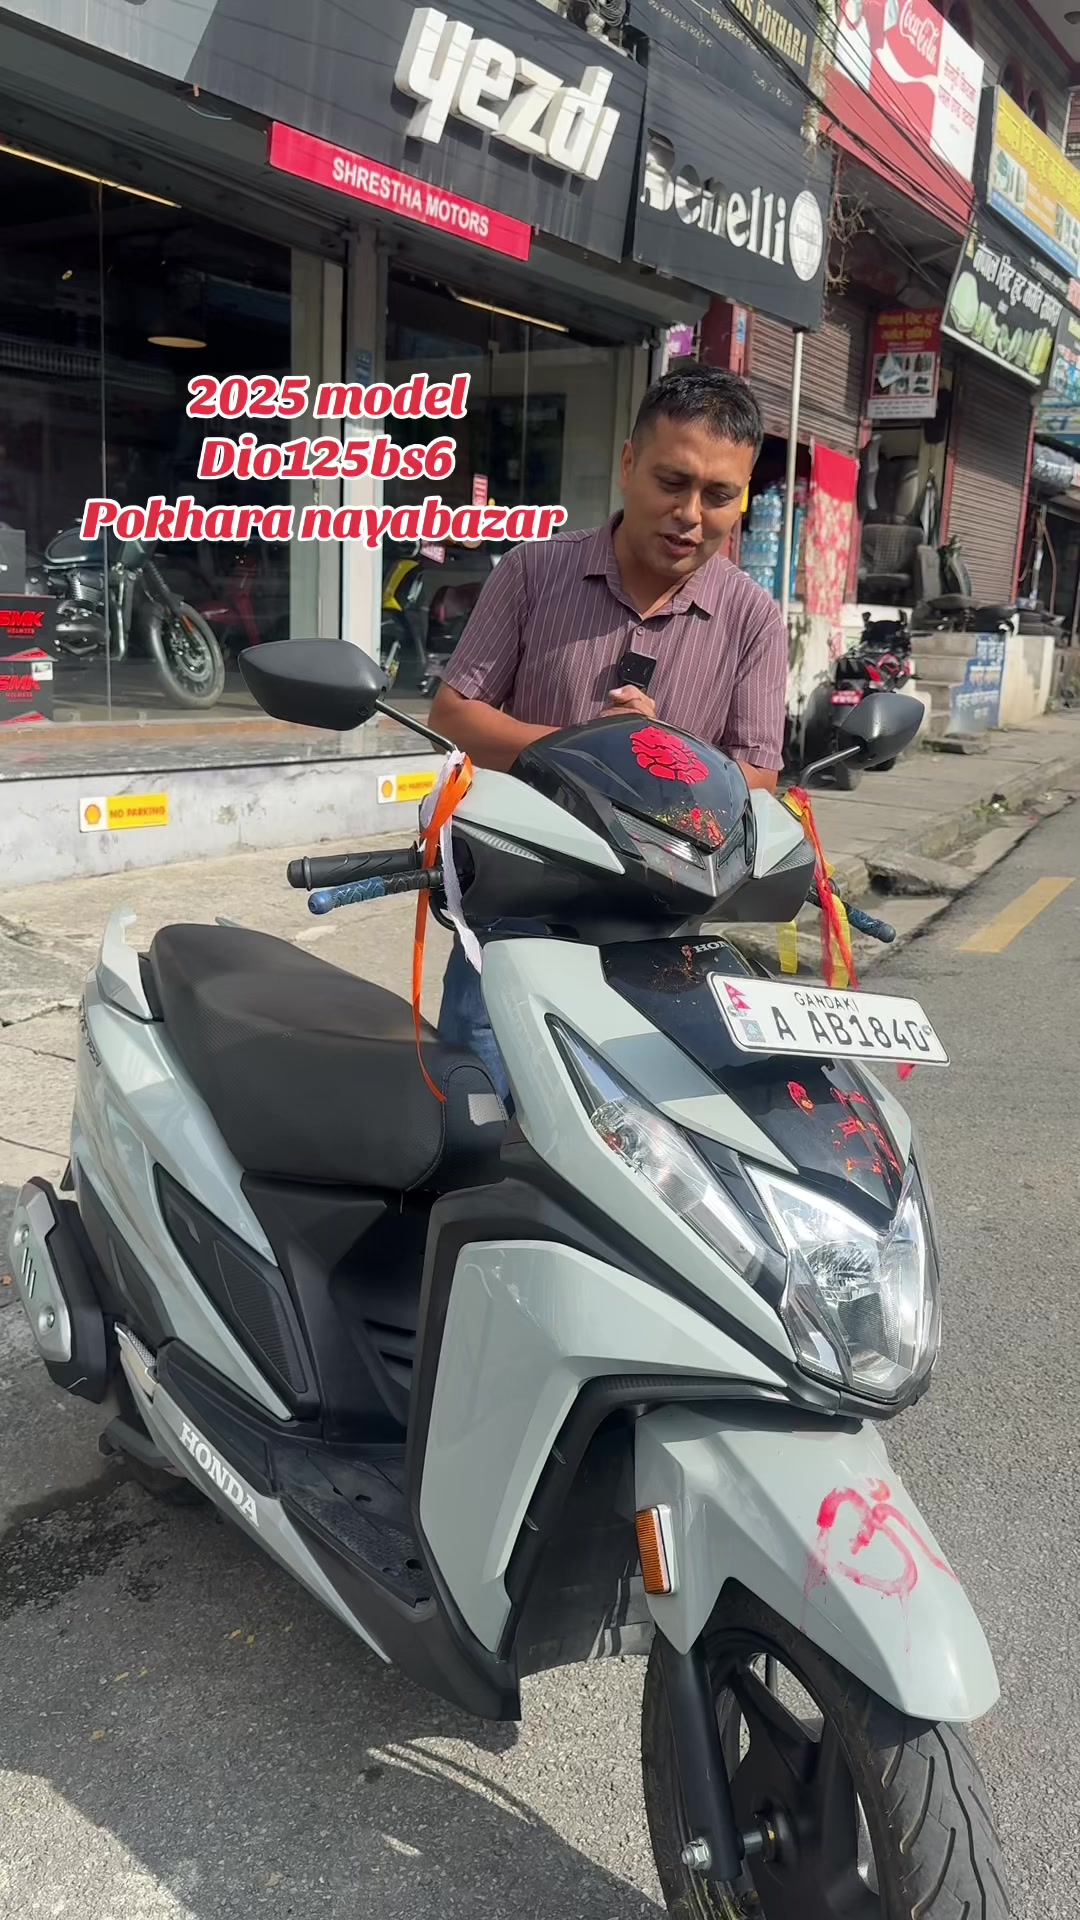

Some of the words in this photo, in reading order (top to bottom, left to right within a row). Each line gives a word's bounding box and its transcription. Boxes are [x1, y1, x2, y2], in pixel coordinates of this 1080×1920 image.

[754, 0, 807, 67] POKHARA
[332, 157, 423, 213] SHRESTHA
[426, 193, 489, 237] MOTORS
[640, 127, 787, 265] Benelli
[0, 610, 45, 628] SMK
[110, 808, 124, 819] NO
[127, 805, 166, 818] PARKING
[771, 1006, 797, 1042] A
[794, 991, 860, 1012] GANDAKI
[179, 1422, 260, 1527] HONDA
